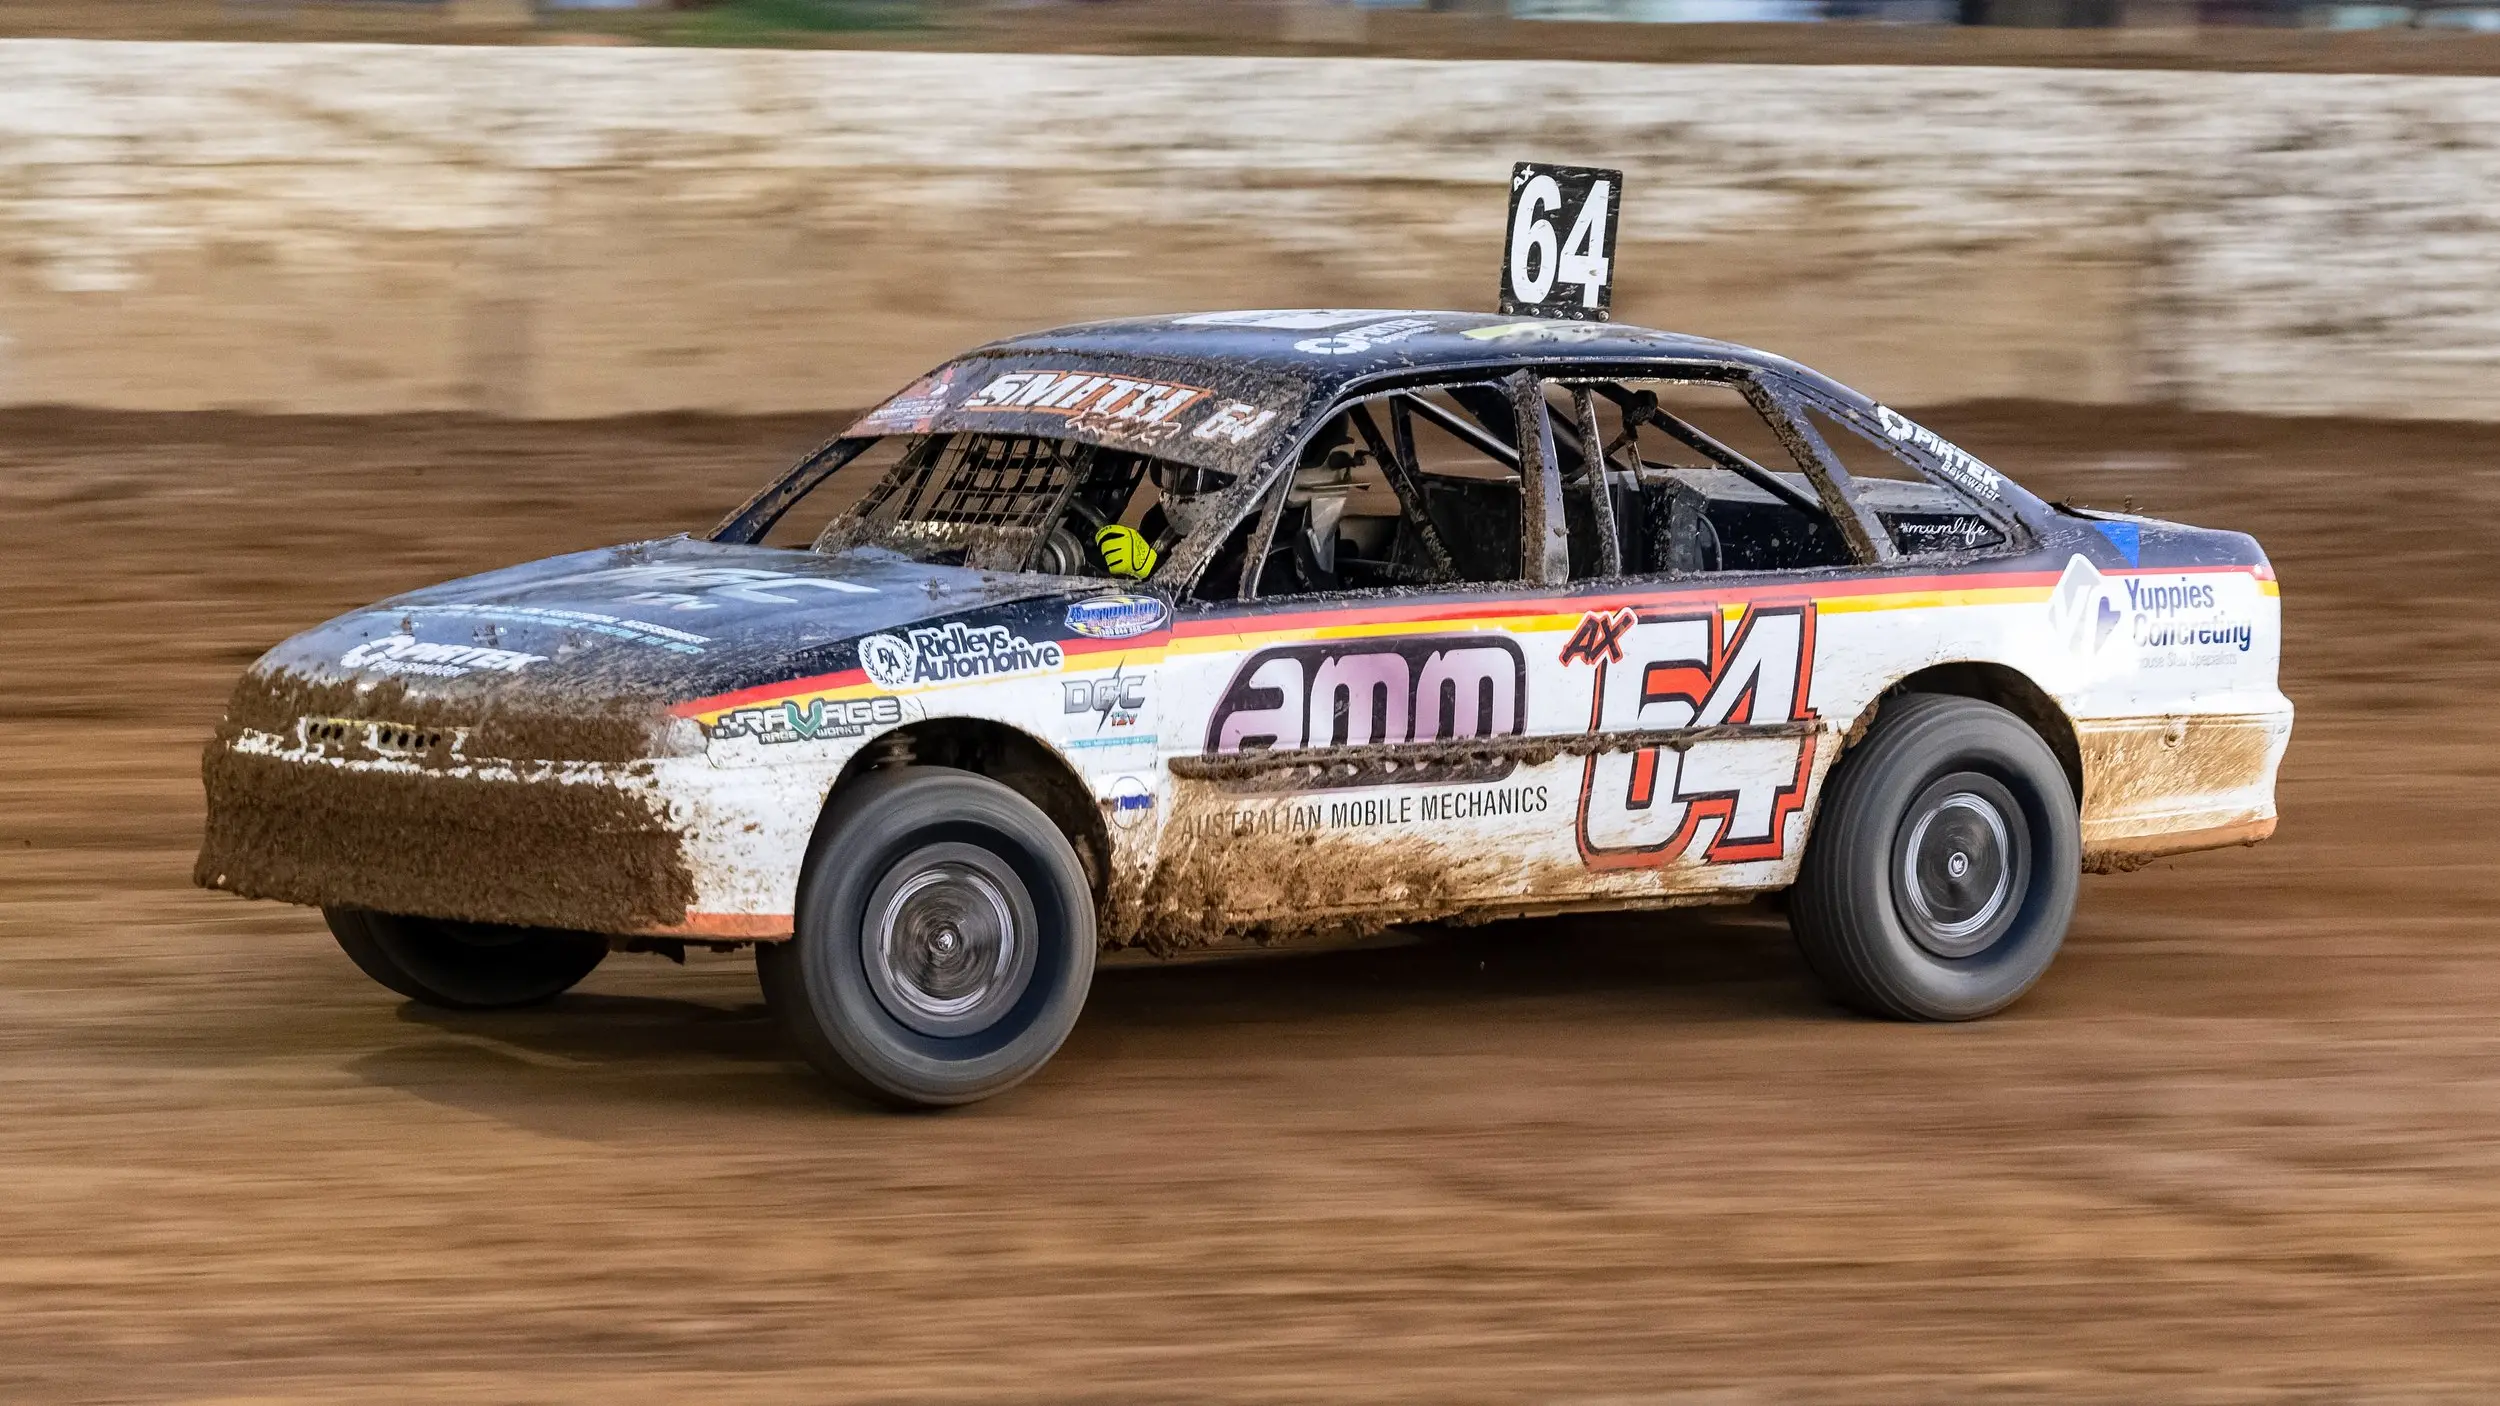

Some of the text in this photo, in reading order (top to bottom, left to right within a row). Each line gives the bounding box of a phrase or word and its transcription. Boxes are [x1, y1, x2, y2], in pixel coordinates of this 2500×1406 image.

[1513, 164, 1535, 192] AX
[1510, 174, 1610, 308] 64
[963, 371, 1199, 426] SMITH
[1192, 399, 1278, 444] 64
[1941, 460, 2000, 501] Bayswater
[2125, 576, 2215, 618] Yuppies
[913, 626, 1010, 659] Ridleys
[1560, 610, 1636, 666] AX
[2133, 610, 2252, 652] Concreting
[913, 642, 1061, 683] Automotive
[1060, 674, 1147, 715] DGC
[1218, 647, 1517, 774] amm
[734, 698, 899, 738] RAVAGE
[816, 725, 863, 738] WORKS
[1575, 602, 1822, 873] 64
[1182, 785, 1549, 839] AUSTRALIAN MOBILE MECHANICS
